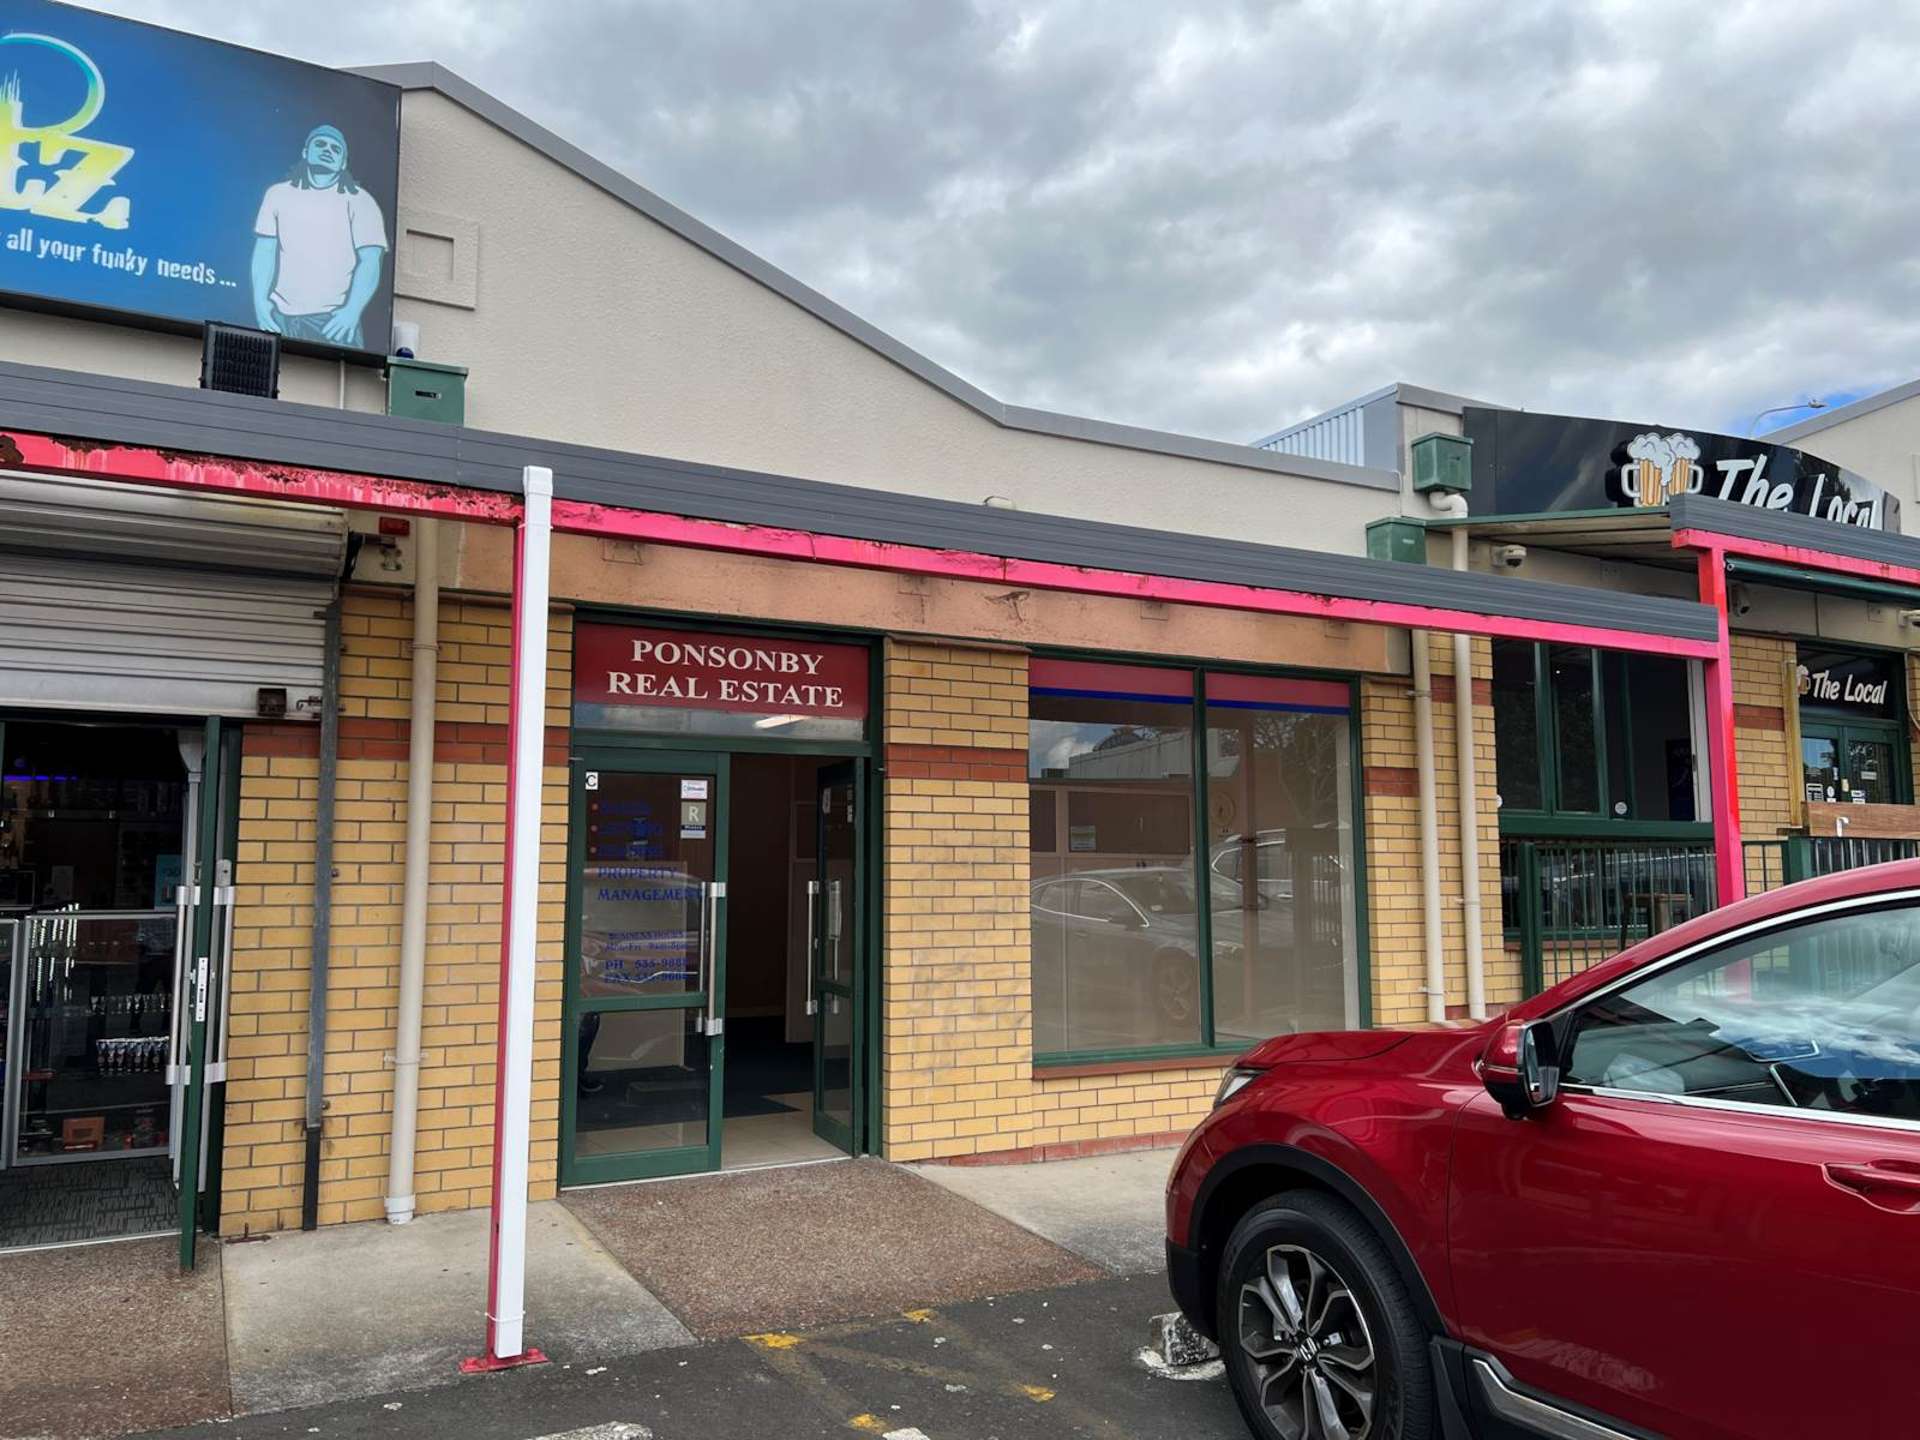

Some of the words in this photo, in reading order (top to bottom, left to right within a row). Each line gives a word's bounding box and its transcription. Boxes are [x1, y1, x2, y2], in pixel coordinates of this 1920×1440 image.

[7, 228, 32, 252] all
[37, 238, 87, 262] your
[92, 243, 148, 276] funky
[1716, 453, 1794, 512] The
[632, 639, 824, 675] PONSONBY
[607, 671, 708, 700] REAL
[719, 679, 844, 708] ESTATE
[1812, 670, 1840, 700] The
[1844, 674, 1887, 704] Local
